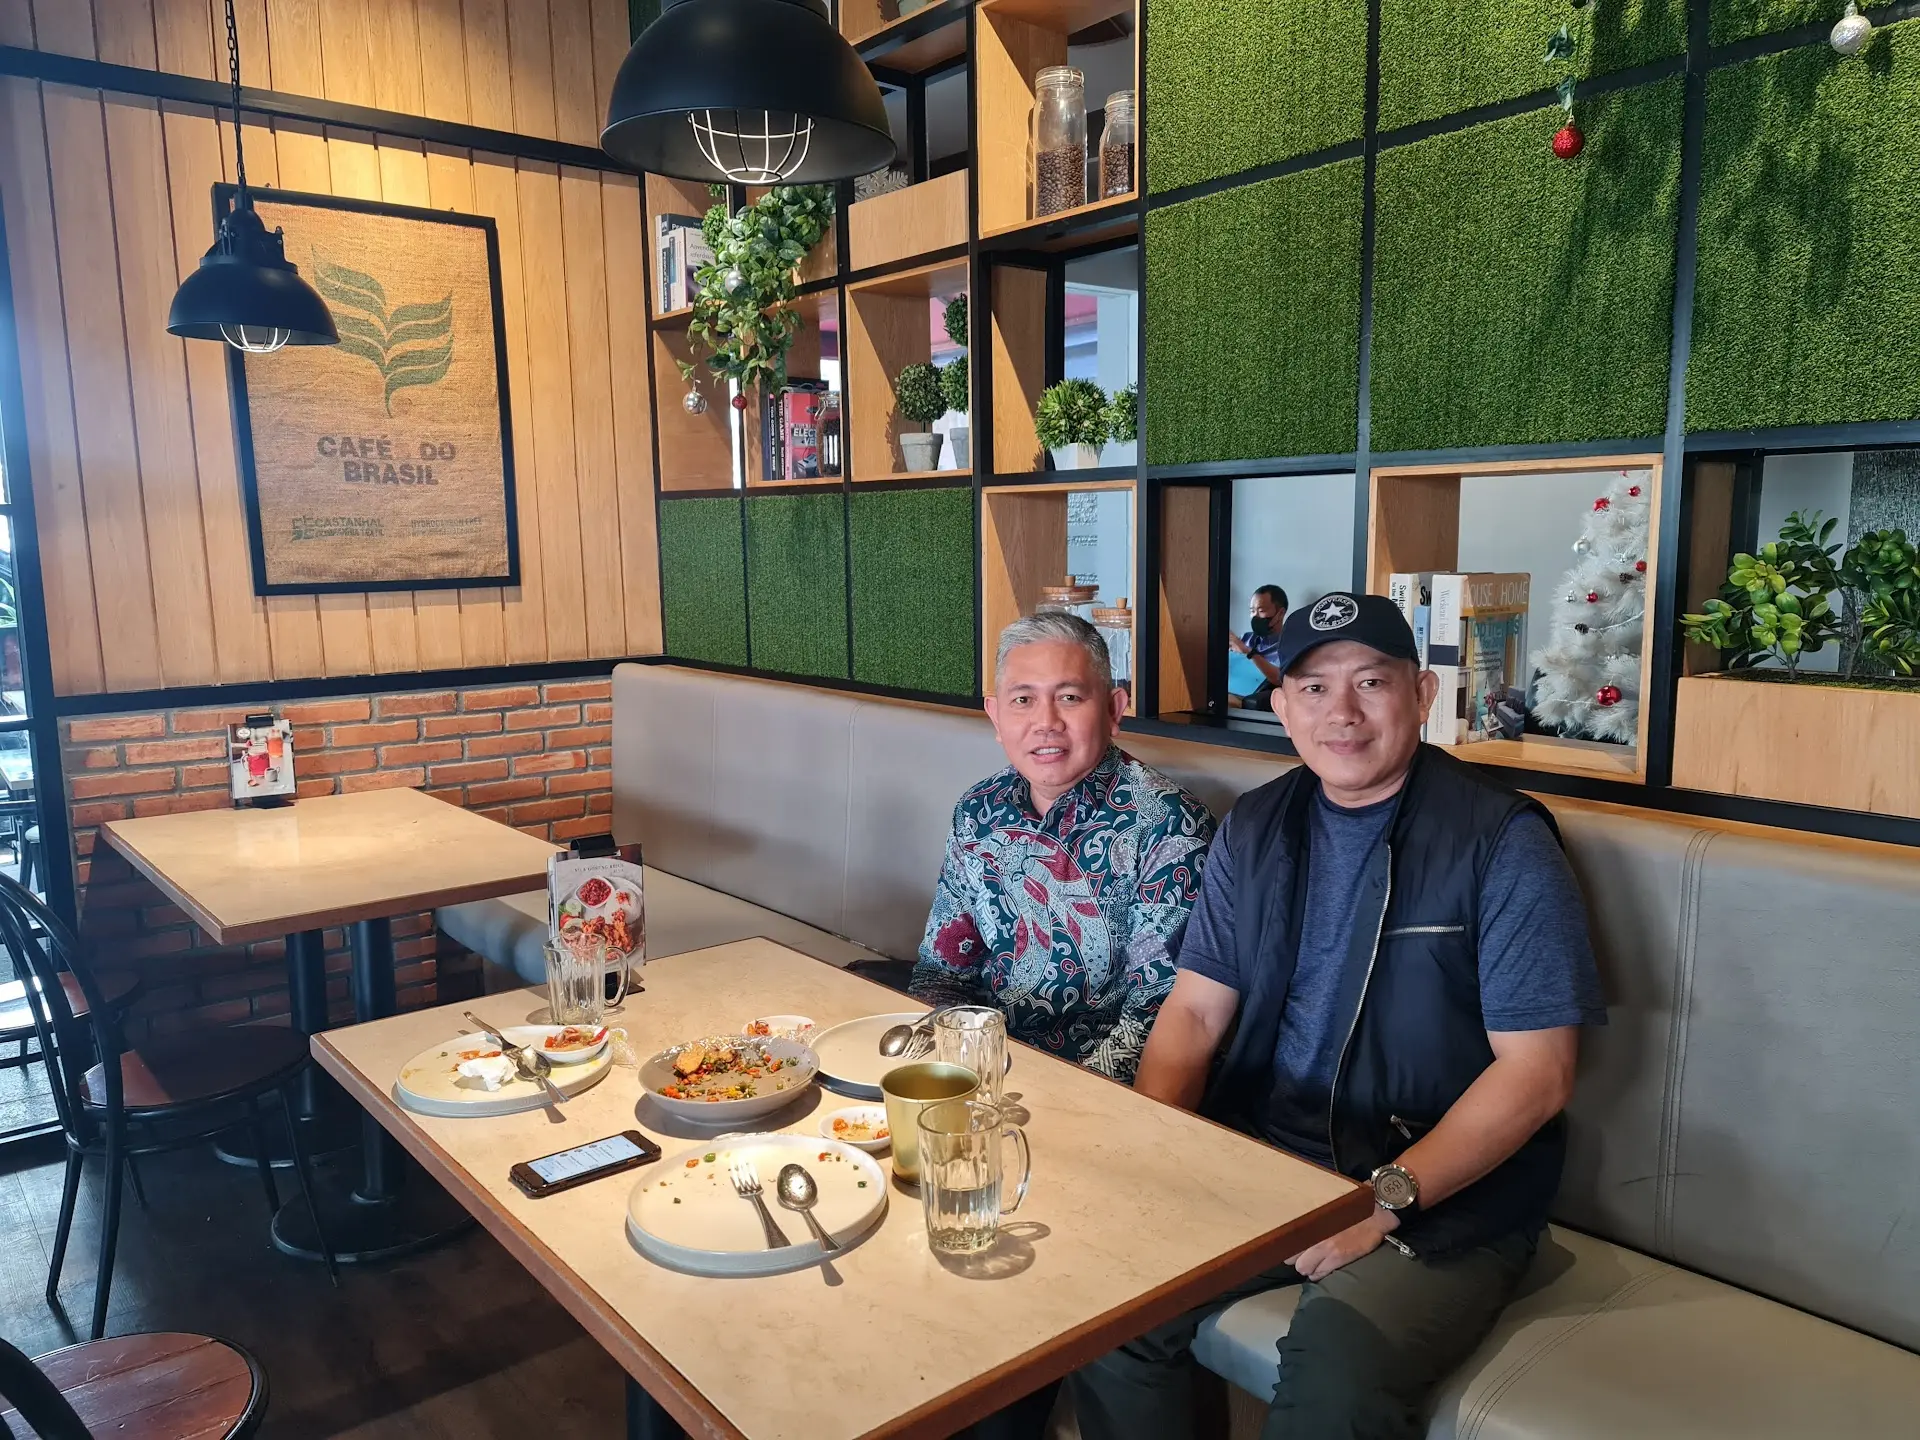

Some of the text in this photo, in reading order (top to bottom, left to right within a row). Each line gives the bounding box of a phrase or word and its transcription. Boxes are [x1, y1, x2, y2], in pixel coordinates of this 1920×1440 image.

[317, 435, 457, 461] CAFÉ DO
[804, 438, 817, 446] VE
[343, 460, 439, 486] BRASIL
[314, 516, 384, 528] CASTANHAL
[1398, 584, 1407, 614] Switch
[1463, 580, 1529, 607] HOUSE HOME
